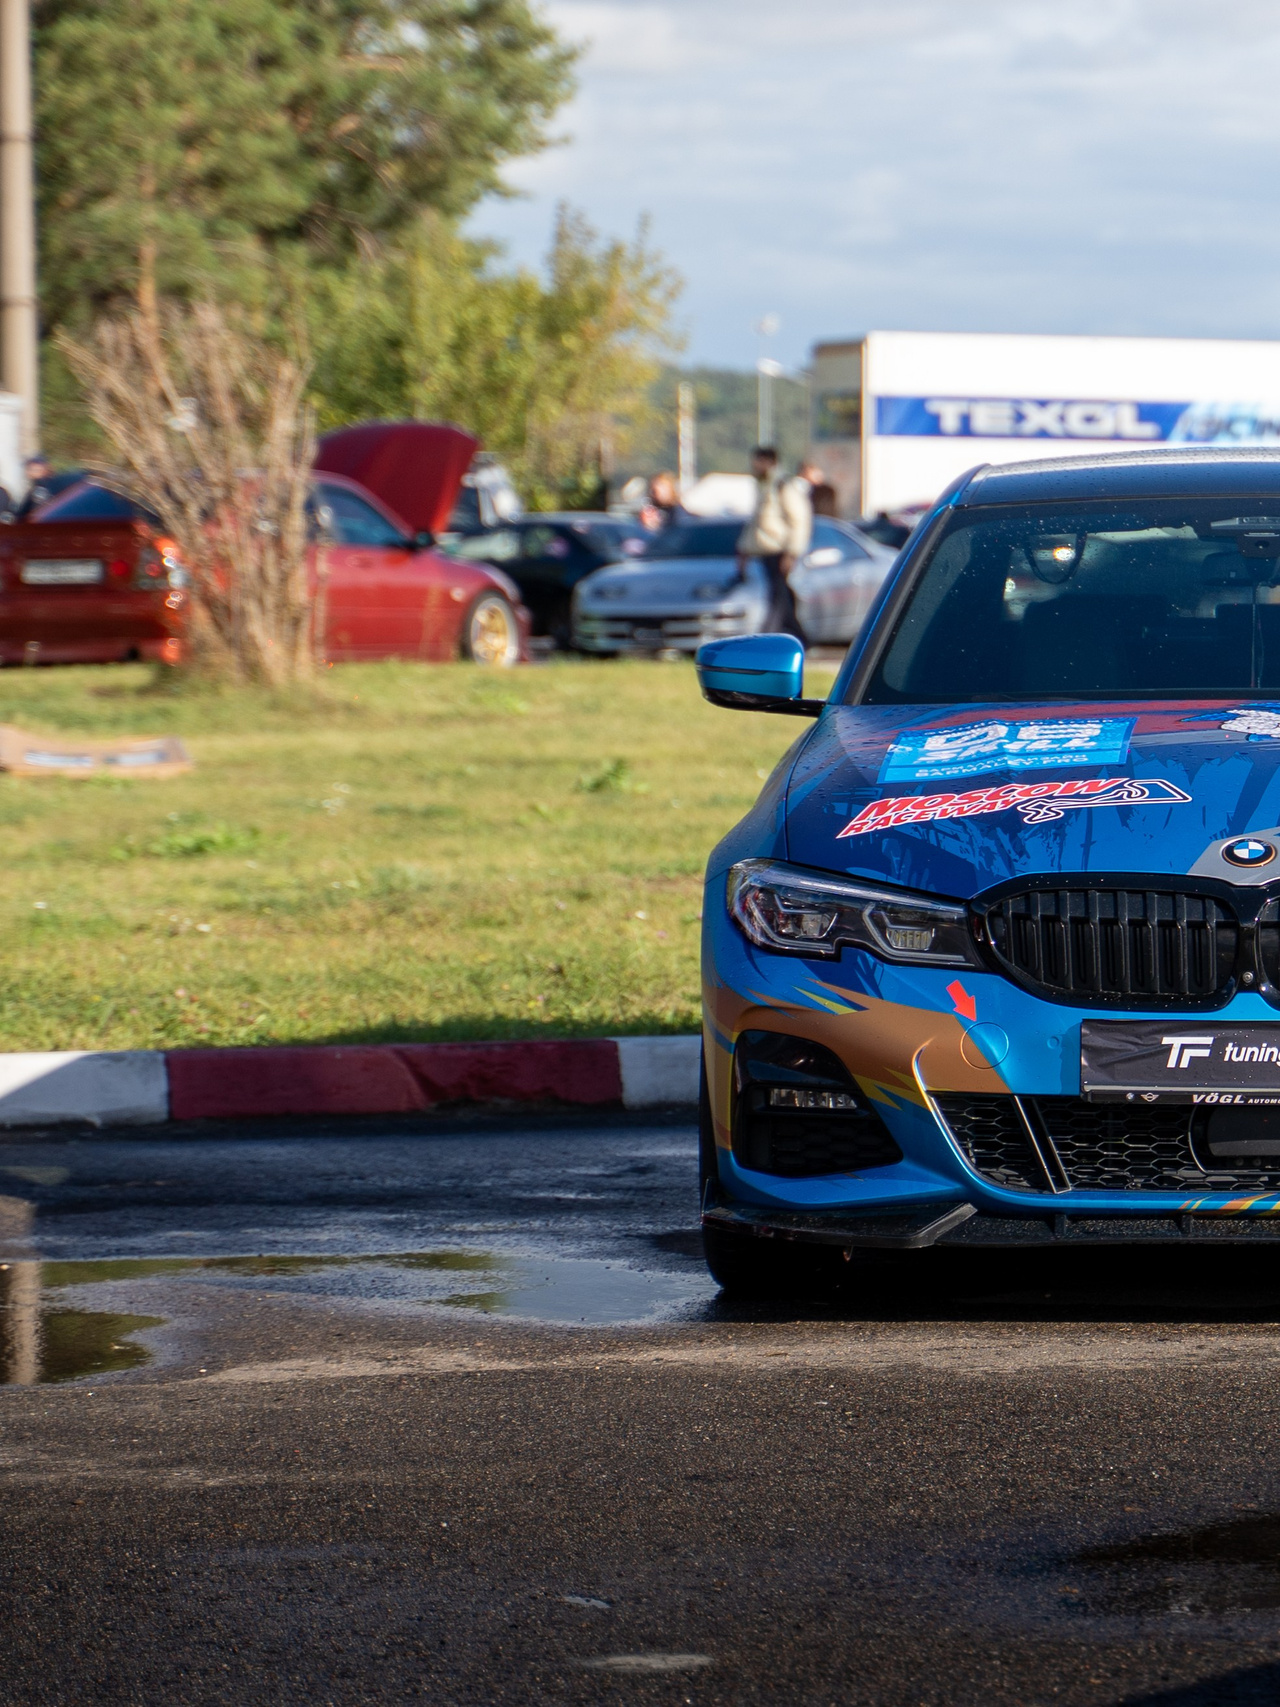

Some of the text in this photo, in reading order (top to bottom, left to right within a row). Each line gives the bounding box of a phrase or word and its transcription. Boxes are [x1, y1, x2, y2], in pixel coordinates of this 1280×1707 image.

[923, 398, 1162, 439] TEXOL
[836, 798, 1022, 838] RACEWAY
[854, 778, 1130, 823] MOSCOW
[1161, 1036, 1215, 1068] TF
[1192, 1092, 1245, 1104] VÖGL
